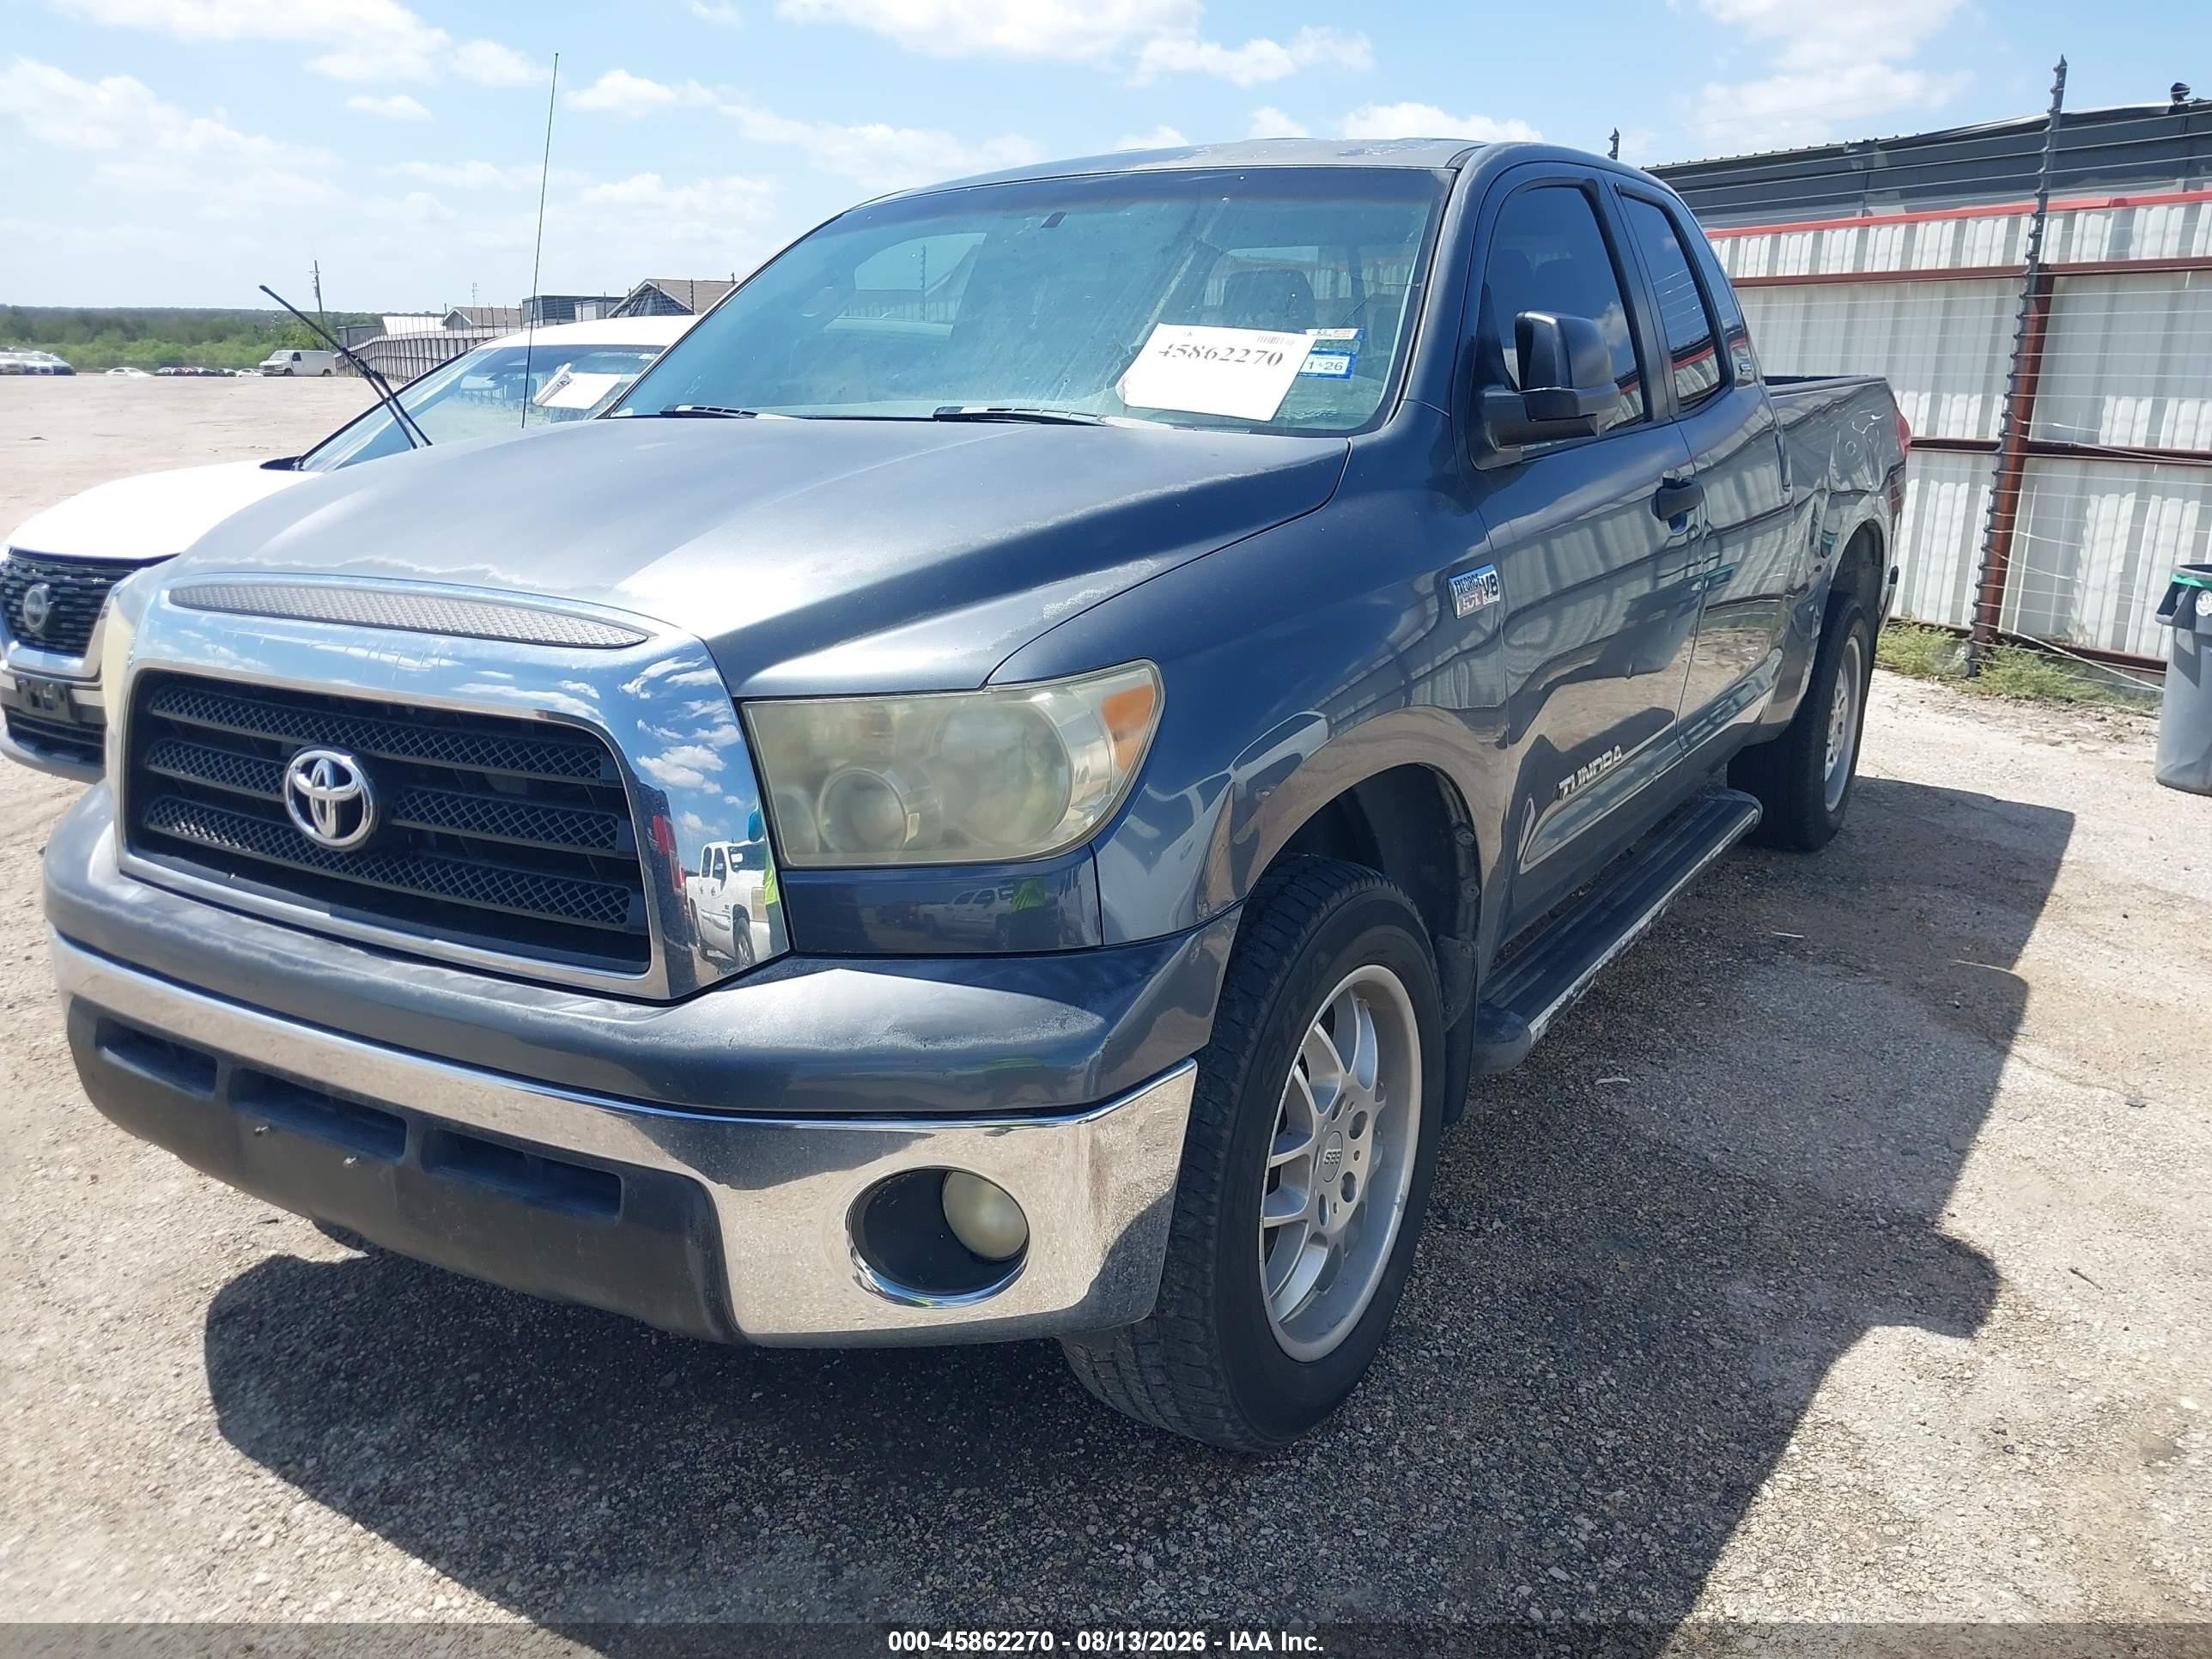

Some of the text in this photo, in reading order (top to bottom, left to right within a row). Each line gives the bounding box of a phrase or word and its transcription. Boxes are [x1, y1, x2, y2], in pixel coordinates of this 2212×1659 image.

[1157, 343, 1285, 368] 45862270
[1480, 574, 1499, 600] V8
[1557, 744, 1622, 801] TUNDRA
